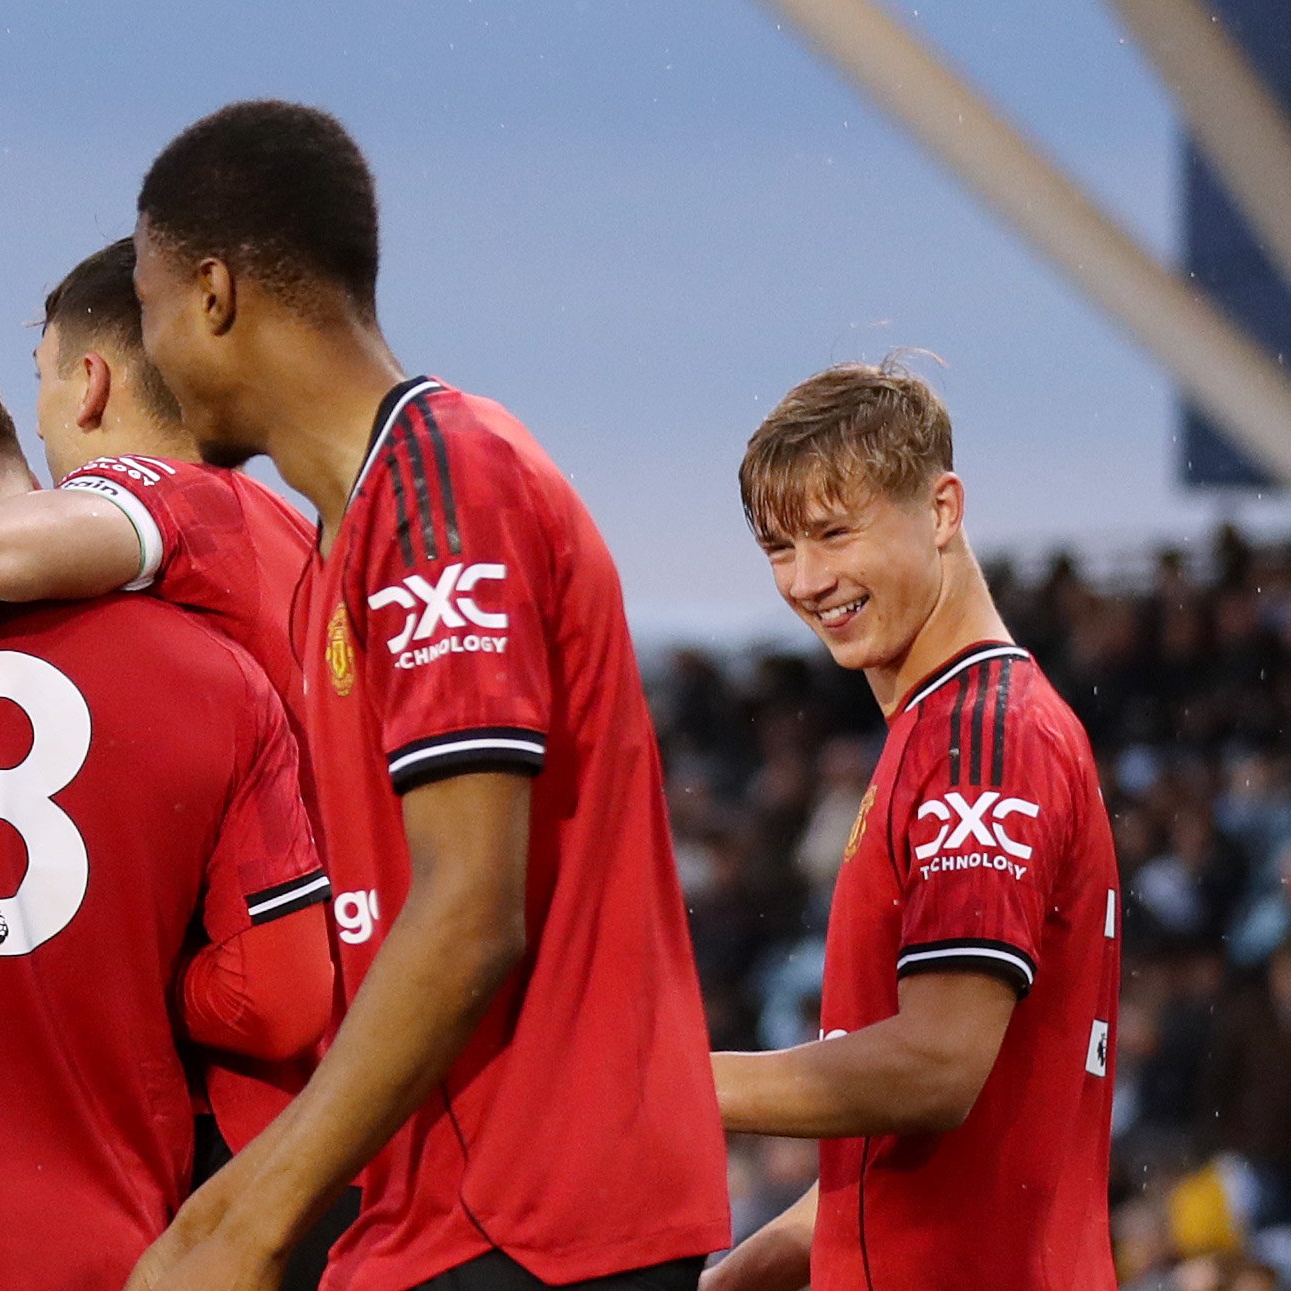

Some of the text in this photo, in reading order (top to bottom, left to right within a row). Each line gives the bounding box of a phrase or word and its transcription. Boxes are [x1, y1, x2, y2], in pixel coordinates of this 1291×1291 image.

[367, 562, 509, 655] DXC
[395, 634, 508, 669] CHNOLOGY
[915, 790, 1040, 861] DXC
